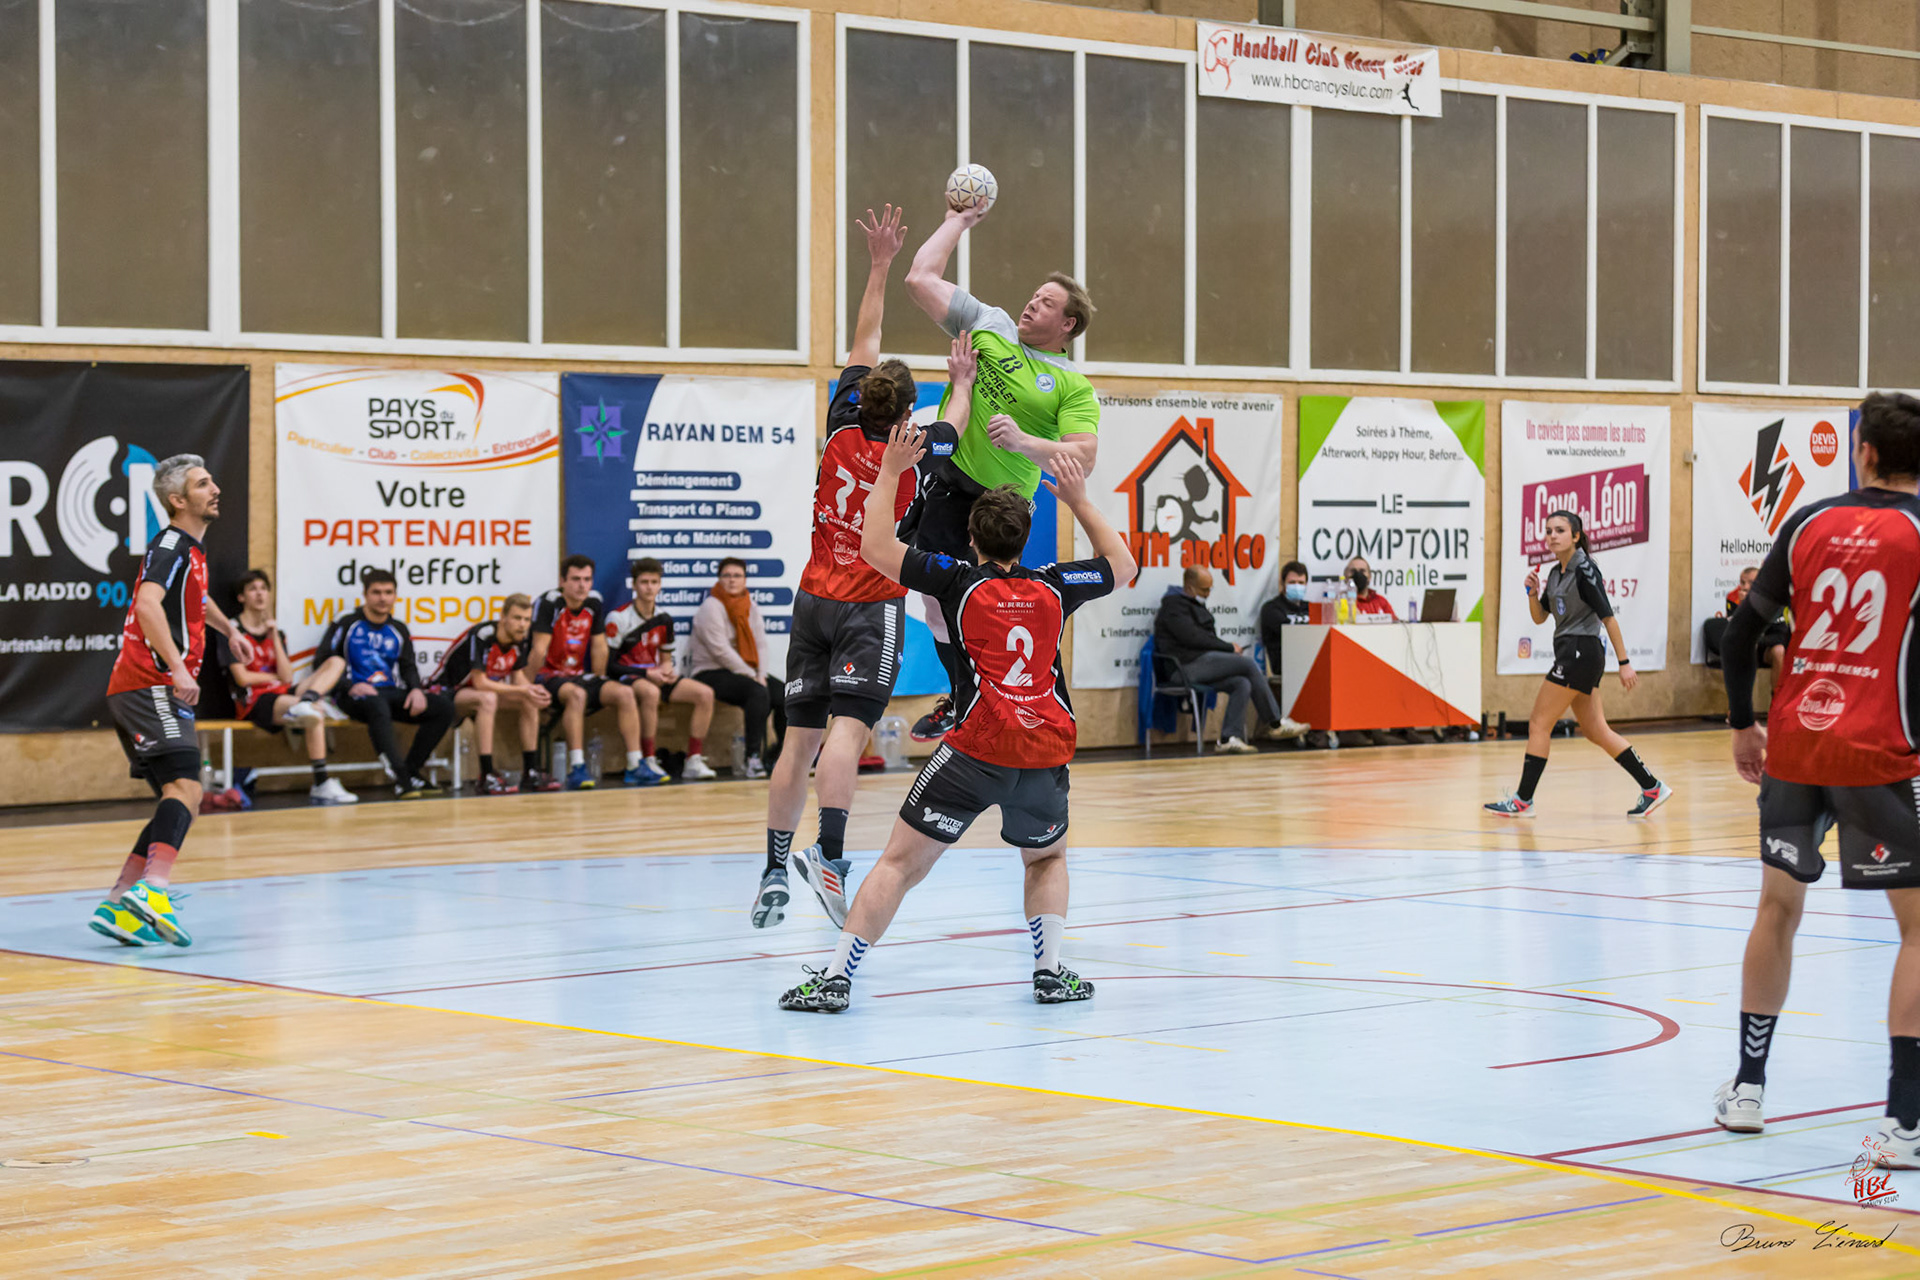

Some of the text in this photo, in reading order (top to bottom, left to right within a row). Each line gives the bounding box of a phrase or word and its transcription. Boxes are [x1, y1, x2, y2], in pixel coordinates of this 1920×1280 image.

[1233, 32, 1298, 63] Handball
[1305, 42, 1339, 68] Club
[1344, 51, 1385, 80] Nancy
[1252, 73, 1393, 100] www.hbcnancysluc.com
[998, 355, 1023, 374] 13
[368, 398, 455, 420] PAYS du
[1155, 396, 1207, 409] ensemble
[1211, 398, 1239, 410] votre
[1241, 399, 1275, 412] avenir
[648, 423, 795, 444] RAYAN DEM 54
[1356, 425, 1433, 440] Soirées à Thème,
[1526, 419, 1646, 444] Un caviste pas comme les autres
[287, 428, 552, 461] Particulier Club Collectivité Entreprise
[1546, 446, 1626, 457] www.lacavedeleon.fr
[1811, 432, 1836, 454] DEVIS GRATUIT
[1321, 447, 1369, 460] Afterwork,
[1371, 447, 1399, 461] Happy
[1402, 448, 1427, 461] Hour,
[636, 472, 734, 489] Déménagement
[376, 480, 465, 507] Votre
[1590, 471, 1638, 531] Léon
[637, 502, 754, 518] Transport de Piano
[1381, 494, 1403, 514] LE
[304, 519, 531, 546] PARTENAIRE
[636, 531, 752, 546] Vente de Matériels
[1312, 527, 1469, 561] COMPTOIR
[1720, 538, 1773, 554] HelloHom
[691, 560, 708, 574] de
[1371, 564, 1439, 594] mpanile
[1621, 578, 1639, 598] 57
[24, 581, 92, 602] RADIO
[96, 580, 133, 608] 90.
[1121, 605, 1238, 616] Constru ation
[1799, 567, 1888, 653] 29
[1220, 626, 1256, 637] projets
[0, 634, 63, 653] artenaire
[64, 634, 83, 651] du
[85, 633, 116, 651] HBC
[1001, 625, 1034, 687] 2
[940, 814, 963, 829] INTER
